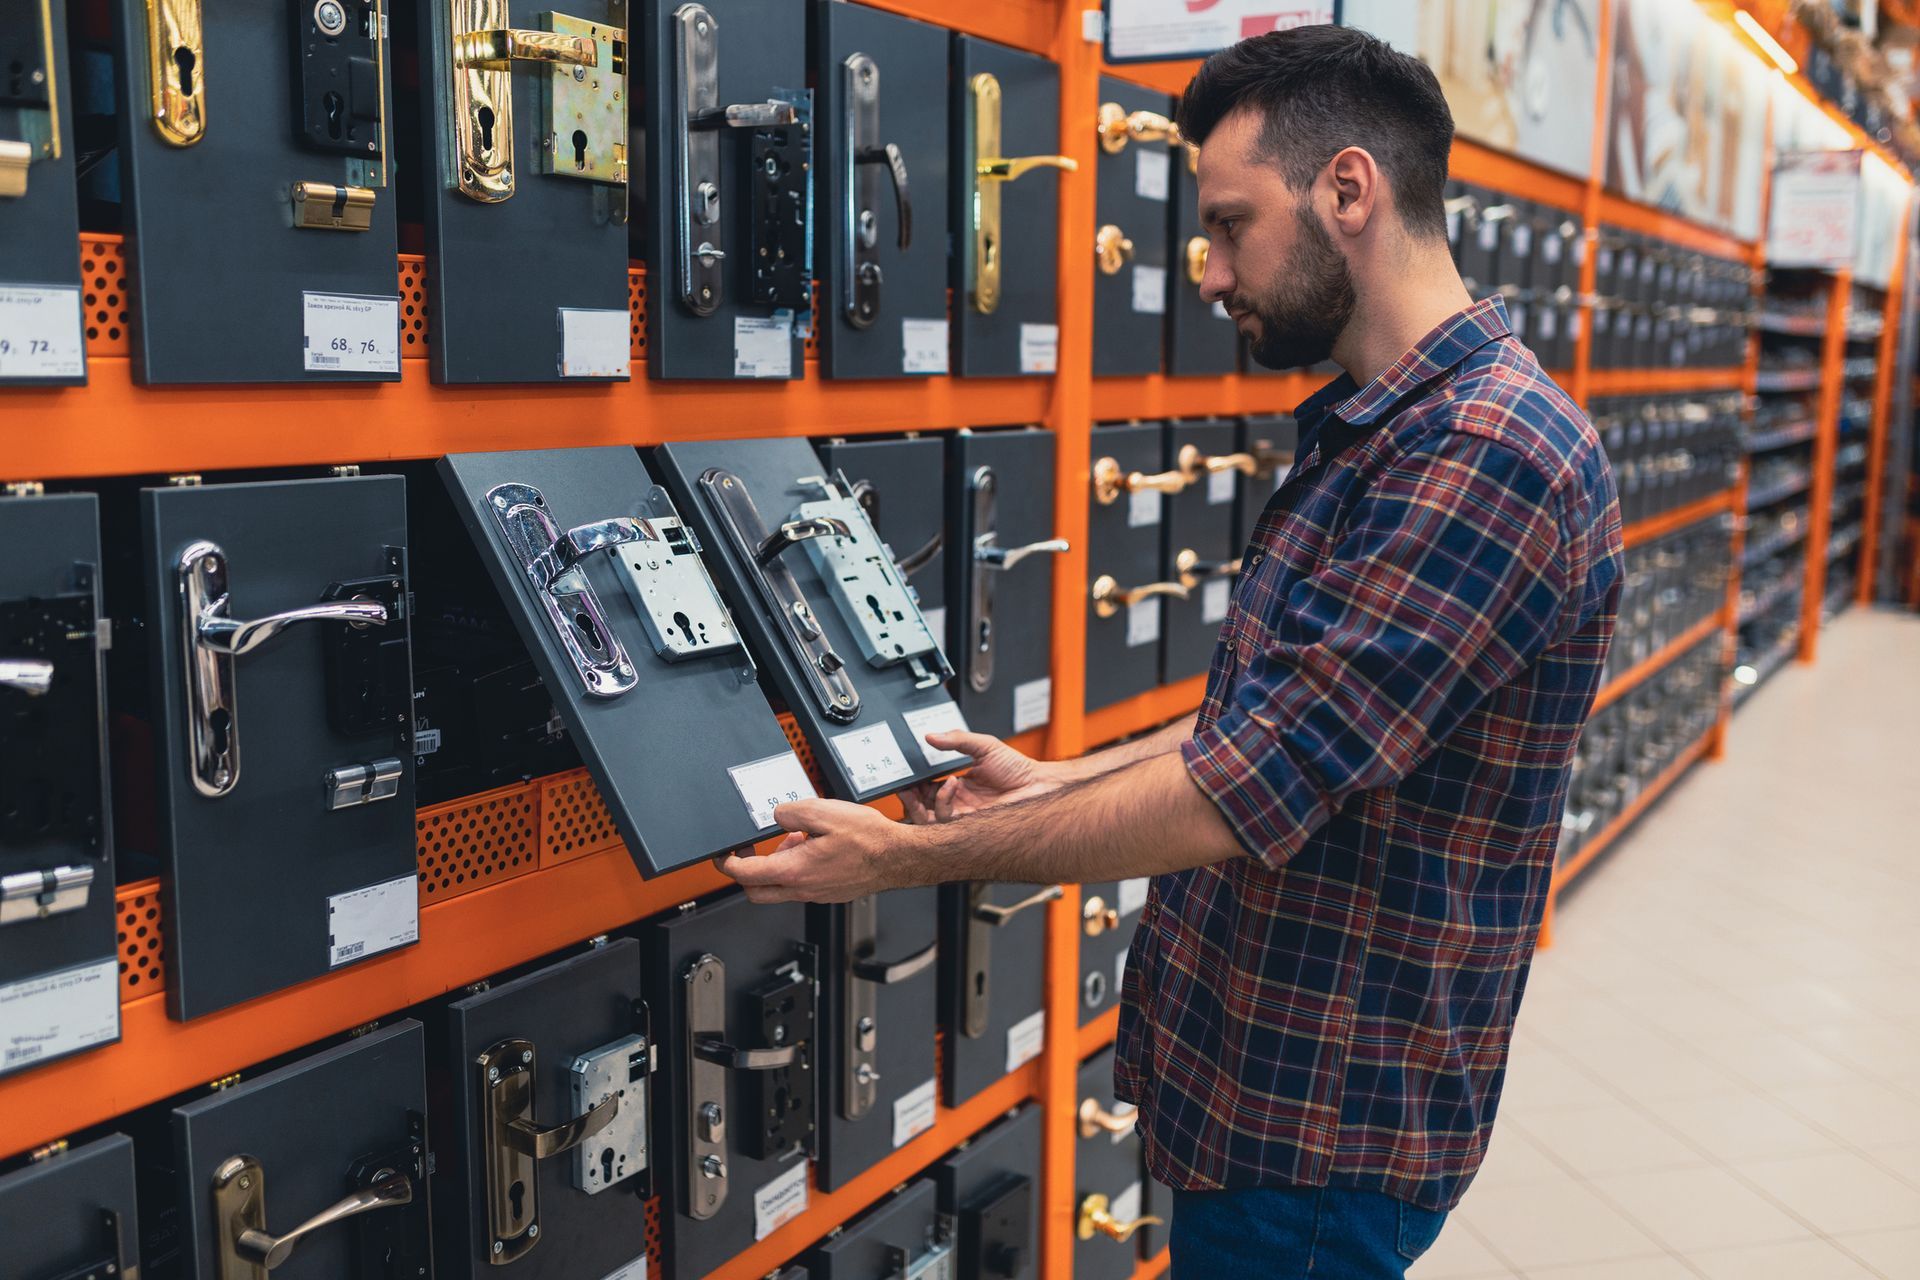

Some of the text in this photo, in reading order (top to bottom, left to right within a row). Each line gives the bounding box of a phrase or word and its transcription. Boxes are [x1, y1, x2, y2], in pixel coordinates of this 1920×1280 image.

[30, 340, 49, 355] 72
[331, 337, 348, 351] 68
[361, 339, 375, 354] 76
[767, 791, 798, 809] 59 39
